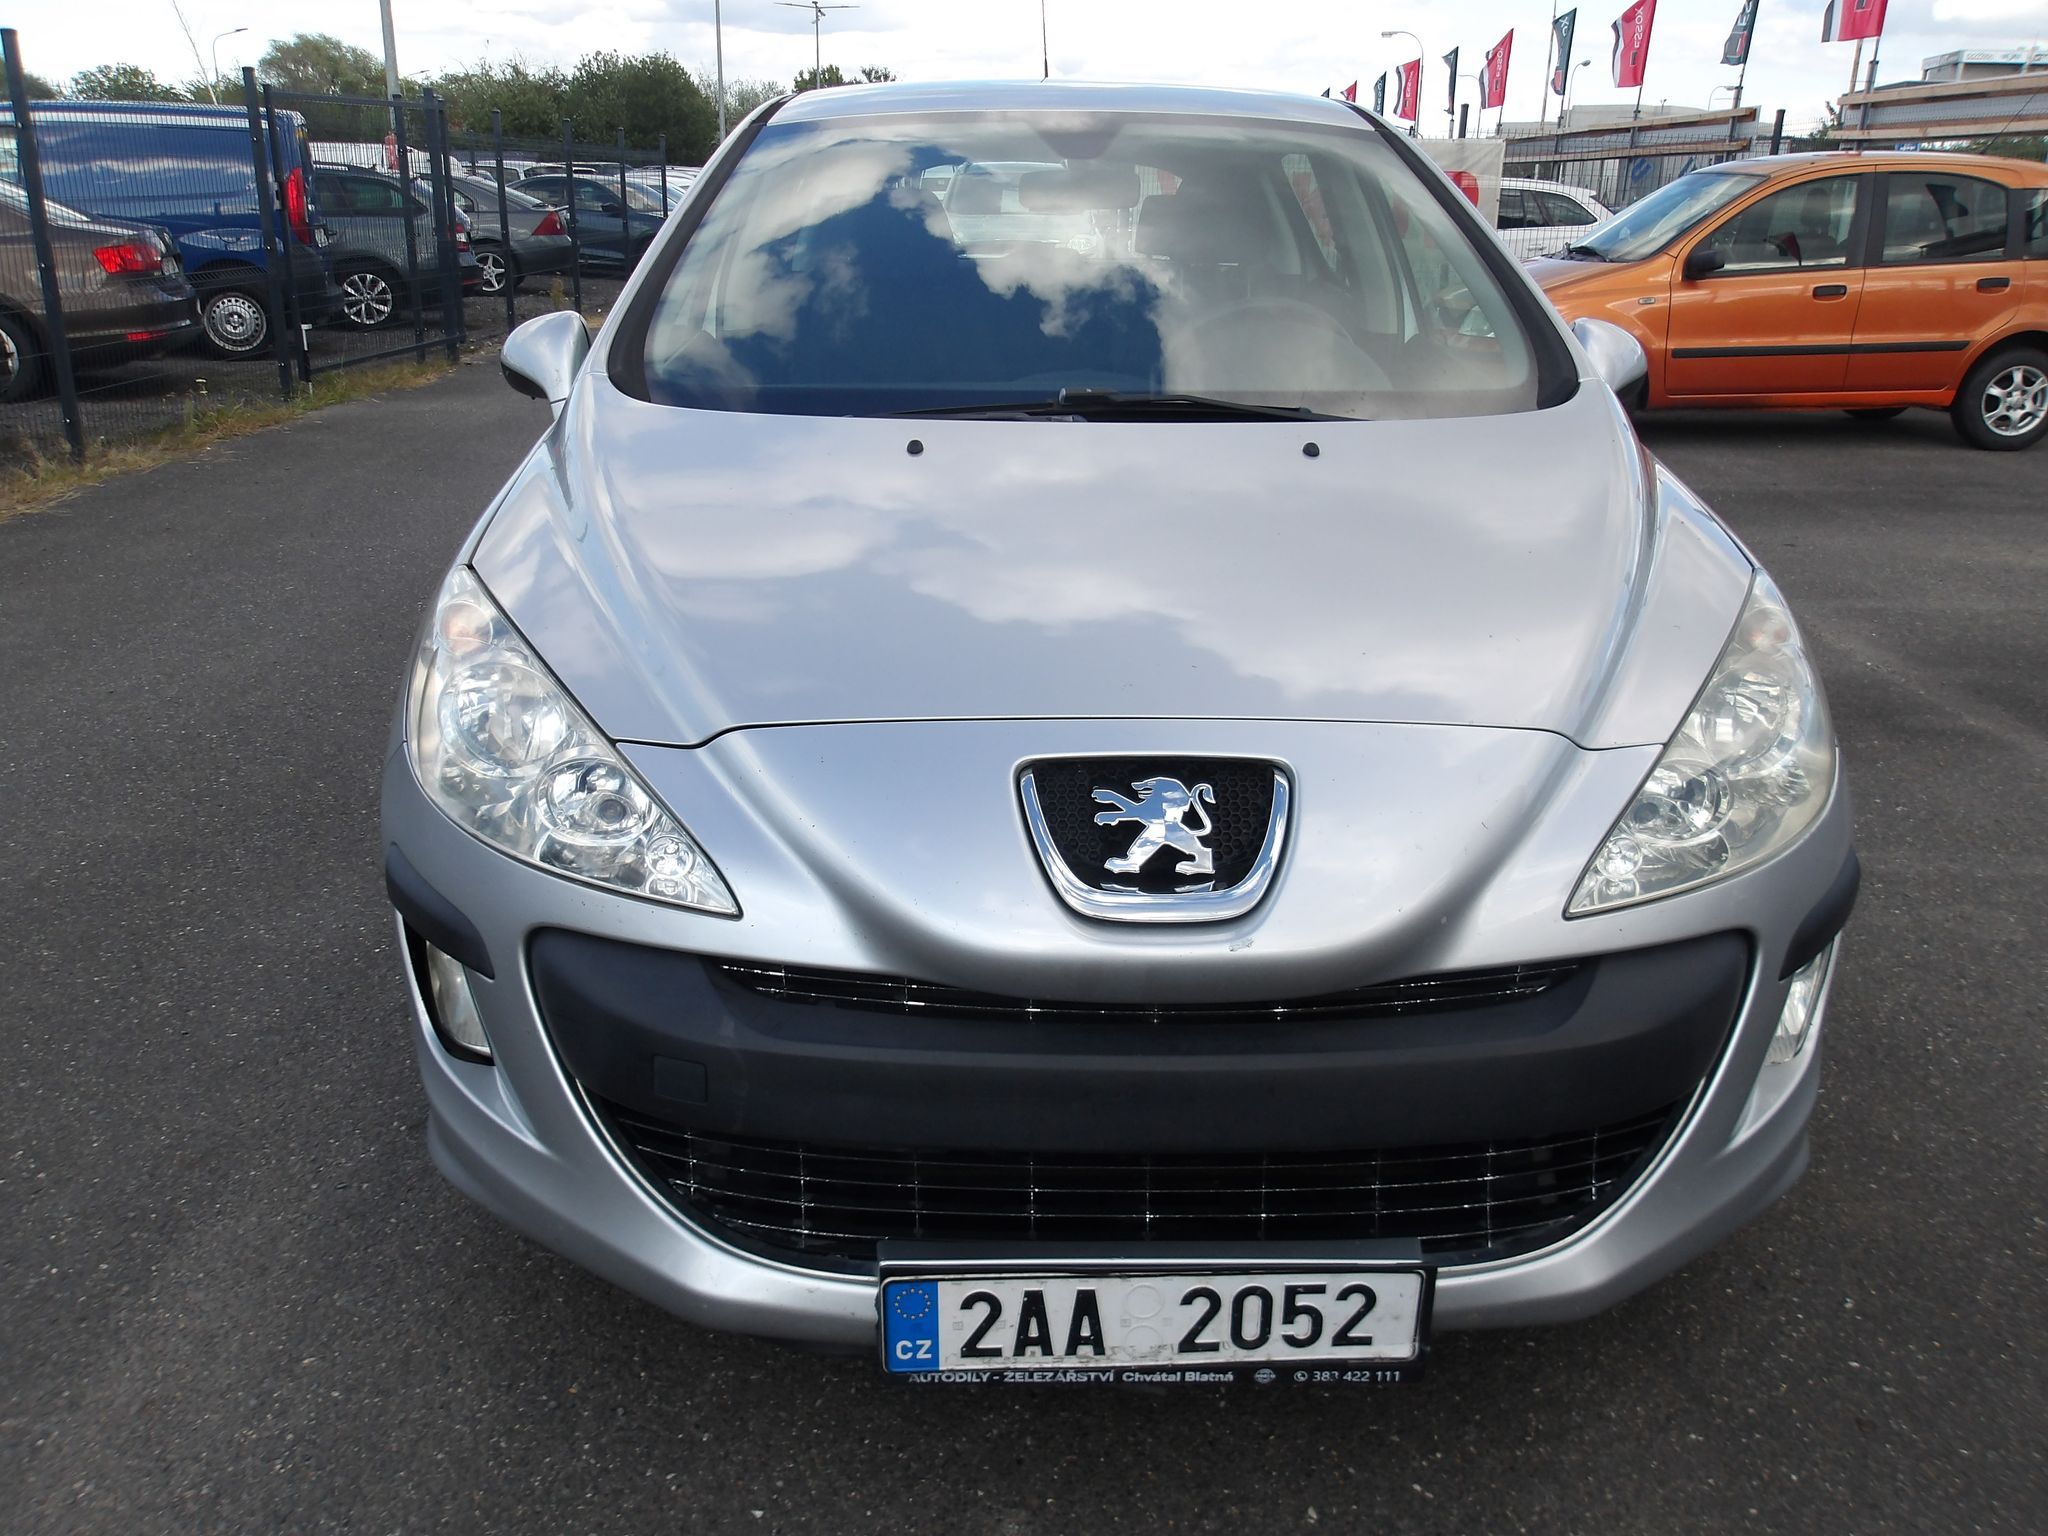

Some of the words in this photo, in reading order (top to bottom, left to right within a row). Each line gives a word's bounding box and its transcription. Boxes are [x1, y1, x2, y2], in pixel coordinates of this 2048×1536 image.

[960, 1288, 1106, 1358] 2AA
[1178, 1282, 1377, 1353] 2052
[895, 1340, 932, 1360] CZ
[1122, 1371, 1181, 1382] Chvátal
[1184, 1371, 1234, 1382] Blatná
[1342, 1371, 1370, 1382] 422
[1376, 1371, 1400, 1382] 111
